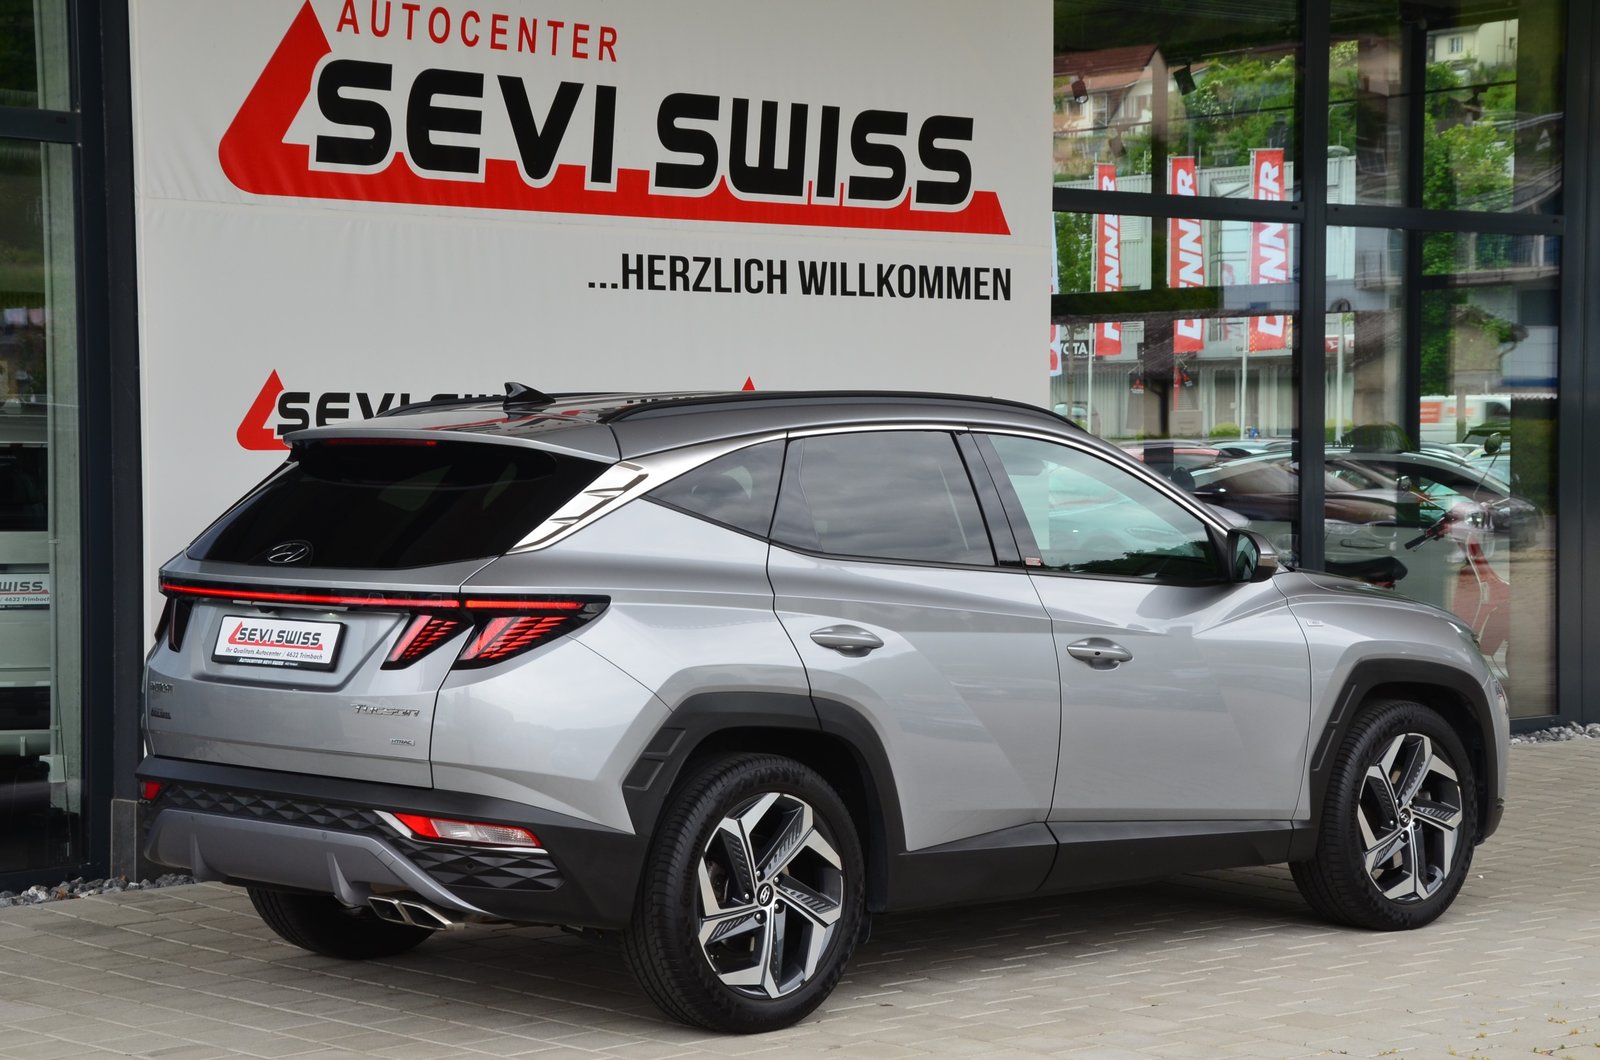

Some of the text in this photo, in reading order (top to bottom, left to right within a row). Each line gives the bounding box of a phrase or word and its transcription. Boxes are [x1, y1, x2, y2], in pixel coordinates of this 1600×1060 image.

[336, 0, 617, 62] AUTOCENTER
[316, 60, 973, 205] SEVI SWISS
[798, 261, 1011, 301] WILLKOMMEN
[238, 627, 321, 646] SEVI SWISS
